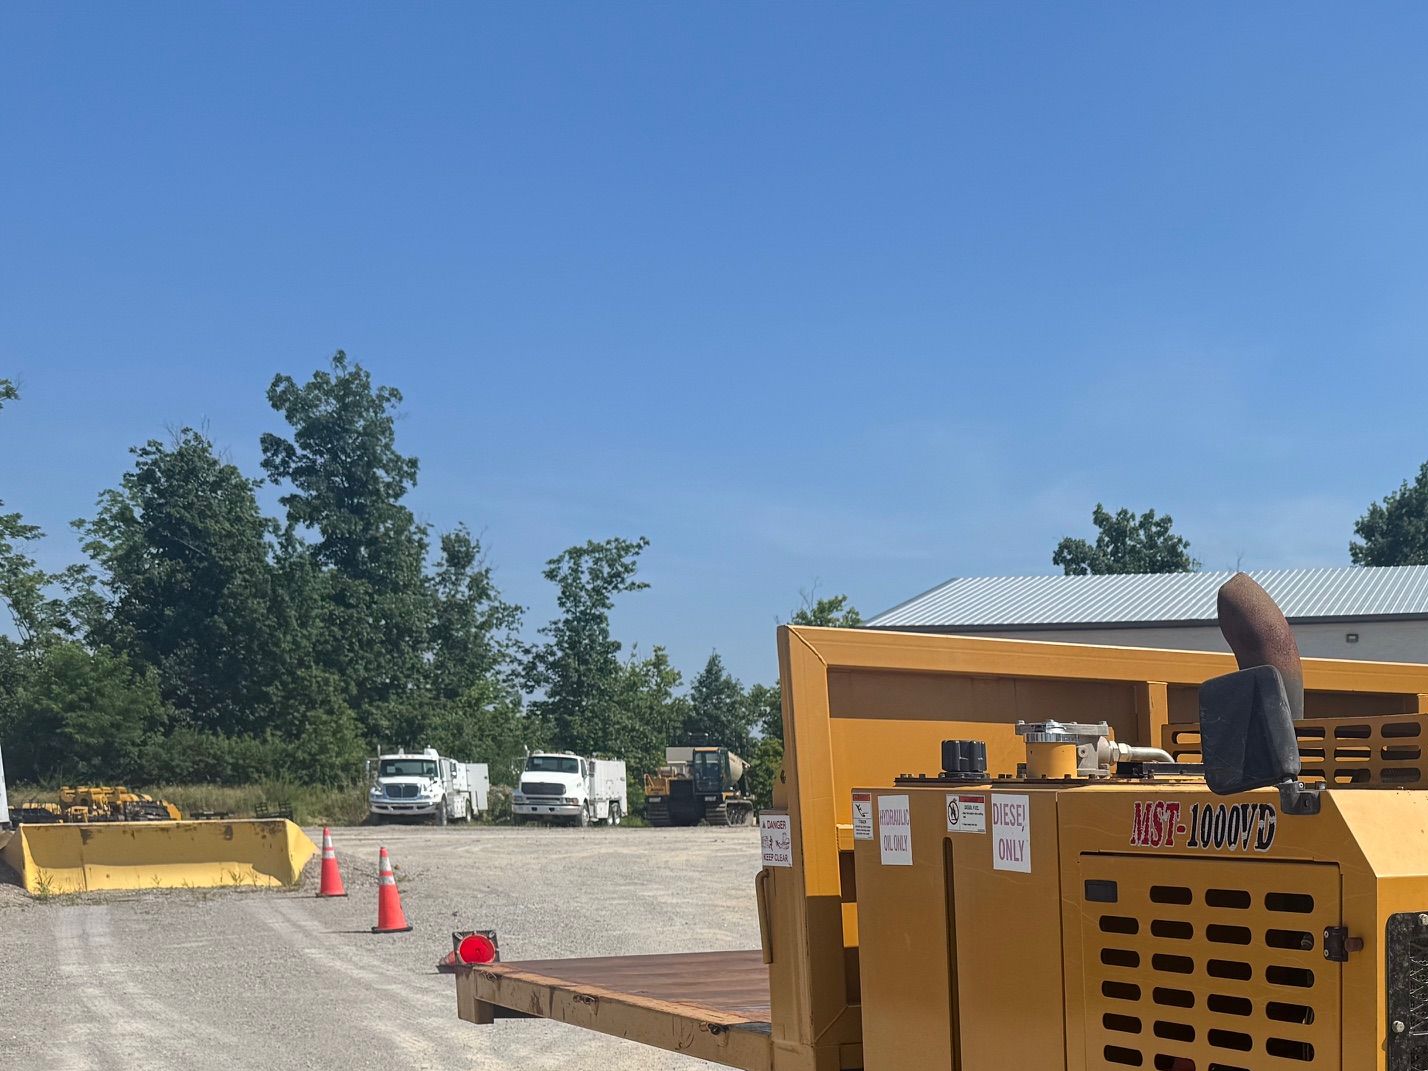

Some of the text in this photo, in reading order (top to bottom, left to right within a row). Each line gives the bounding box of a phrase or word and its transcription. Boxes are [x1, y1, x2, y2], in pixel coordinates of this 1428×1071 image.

[766, 820, 787, 830] DANGER
[879, 808, 910, 826] HYDRAULIC
[1130, 800, 1277, 852] MST-1000VD
[883, 834, 908, 852] OIL ONLY
[998, 838, 1025, 862] ONLY
[763, 853, 788, 862] KEEP CLEAR
